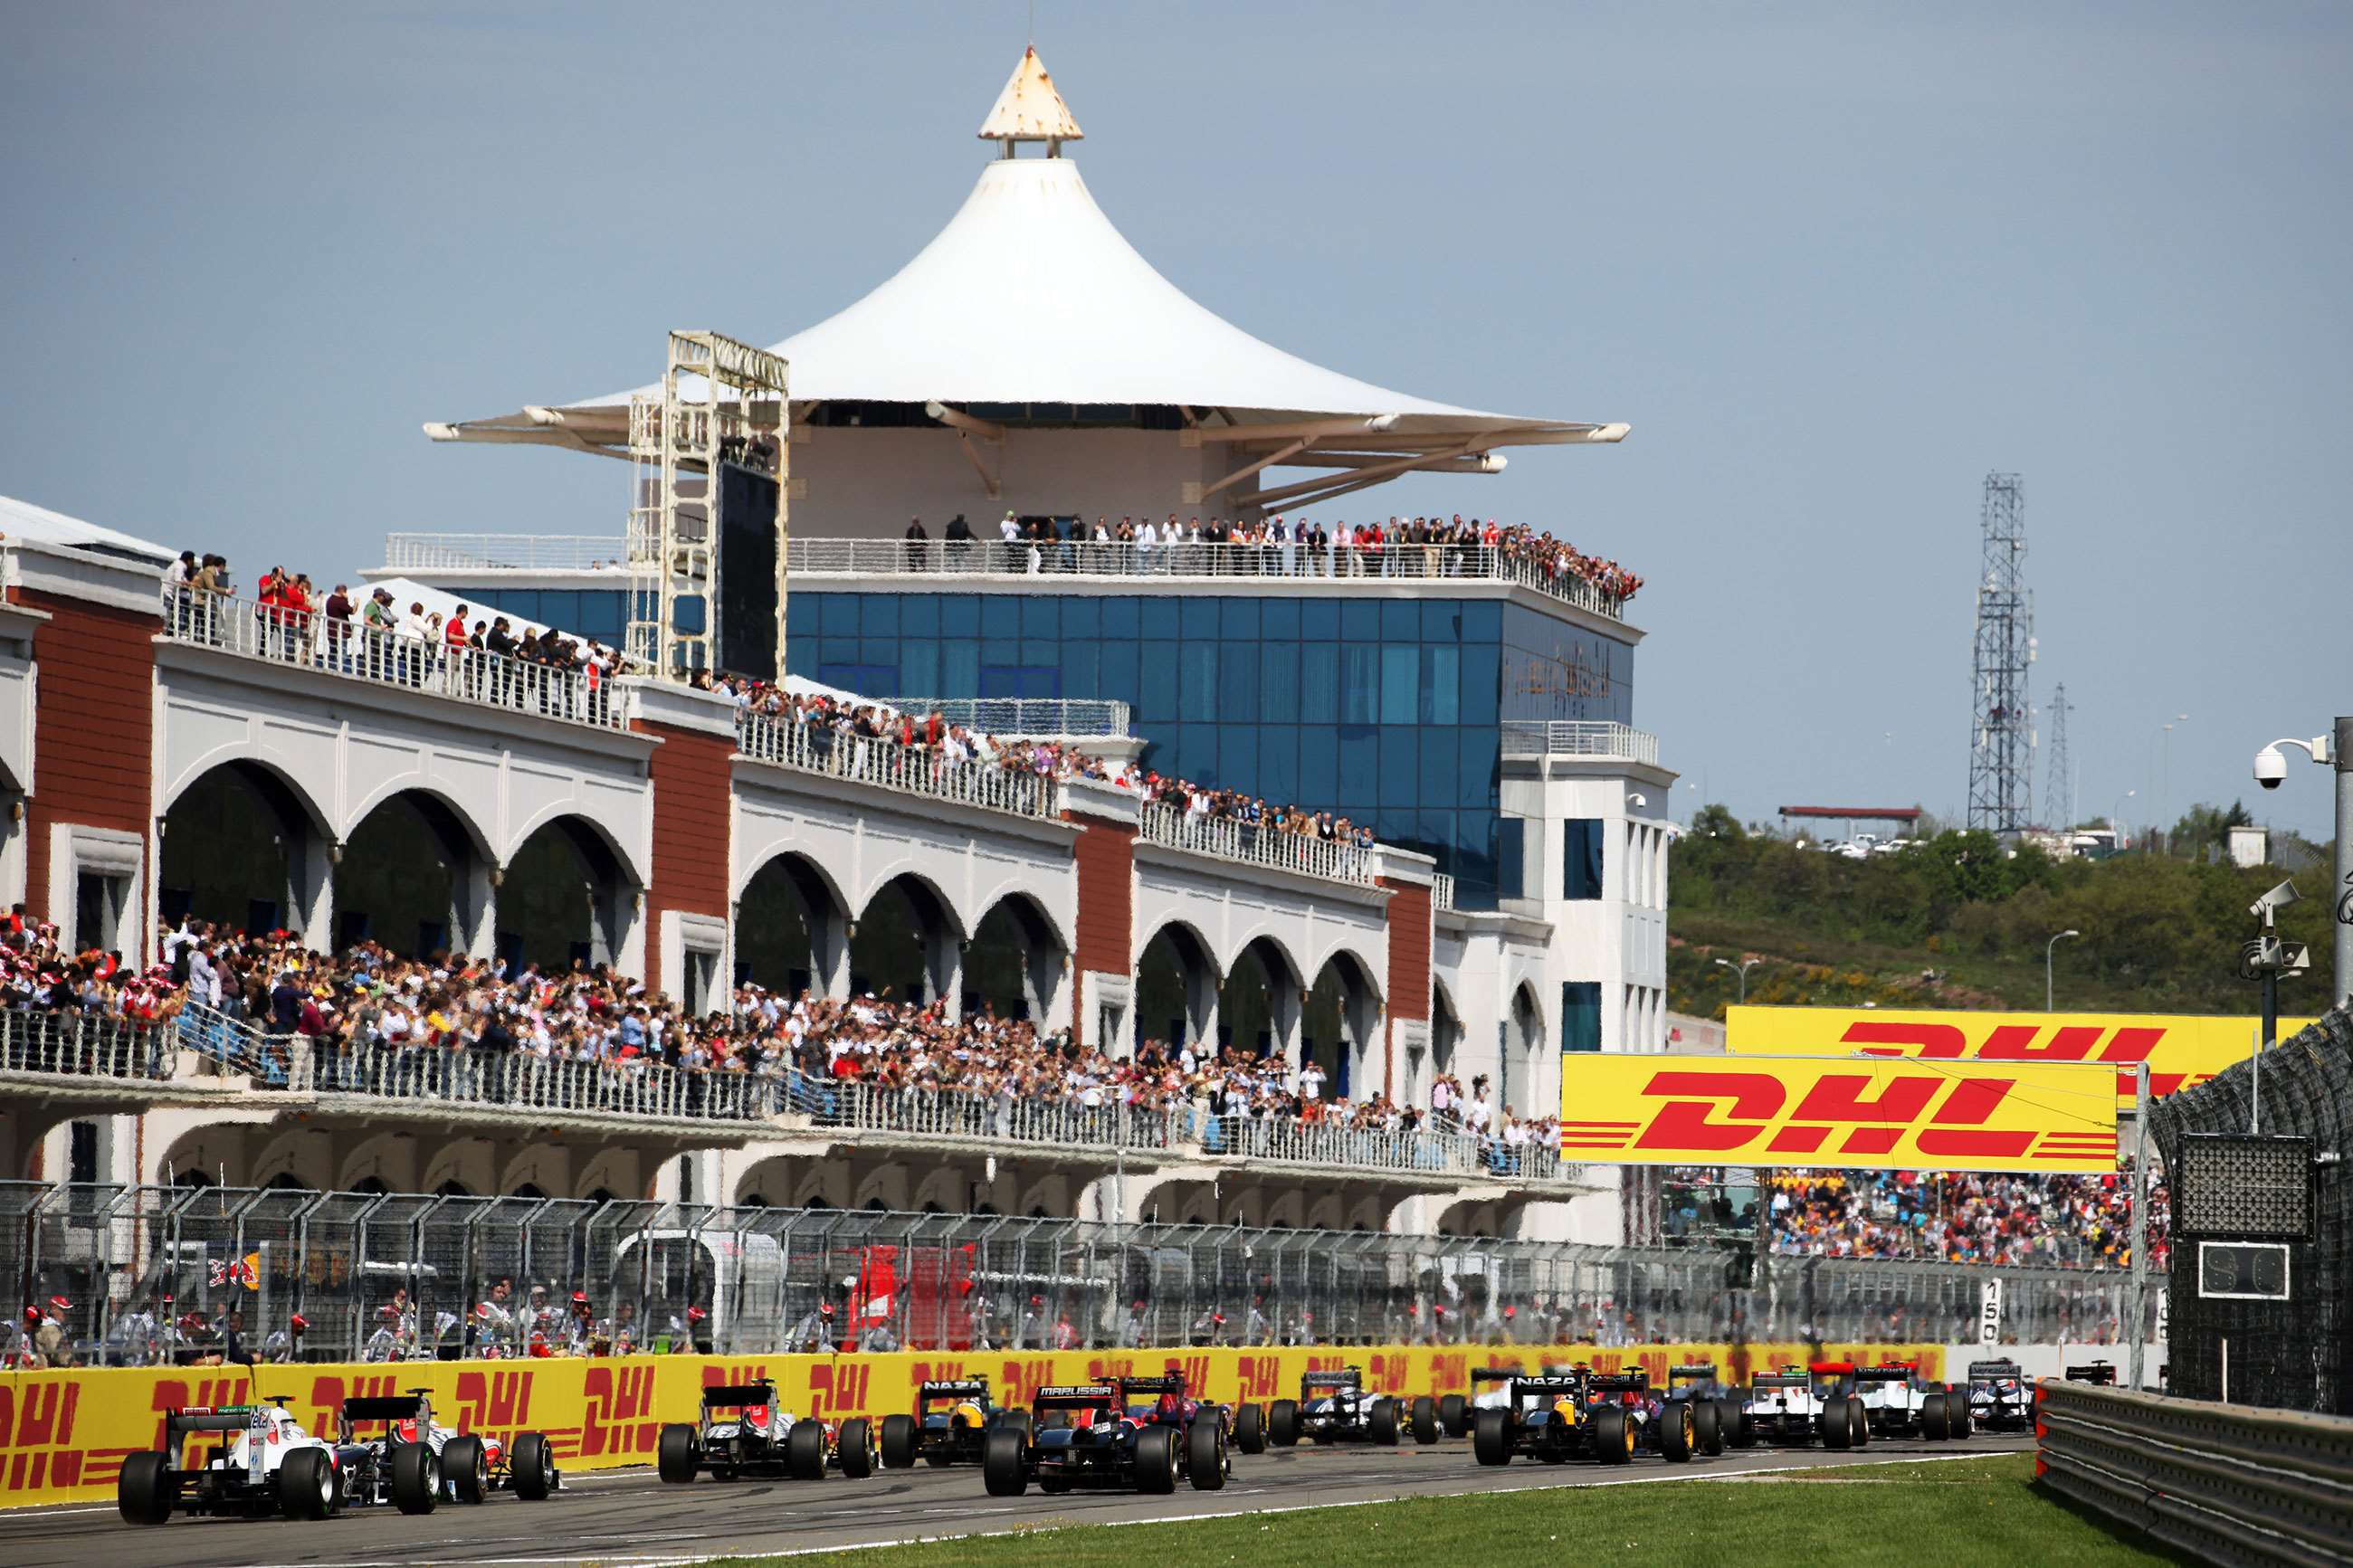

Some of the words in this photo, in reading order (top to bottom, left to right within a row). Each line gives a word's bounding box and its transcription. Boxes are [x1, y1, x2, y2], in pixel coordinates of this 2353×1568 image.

[1634, 1071, 2039, 1157] DHL
[1983, 1280, 1998, 1340] 150
[580, 1365, 658, 1457] DHL
[1041, 1386, 1112, 1396] MARUSSIA
[1517, 1376, 1576, 1386] NAZA
